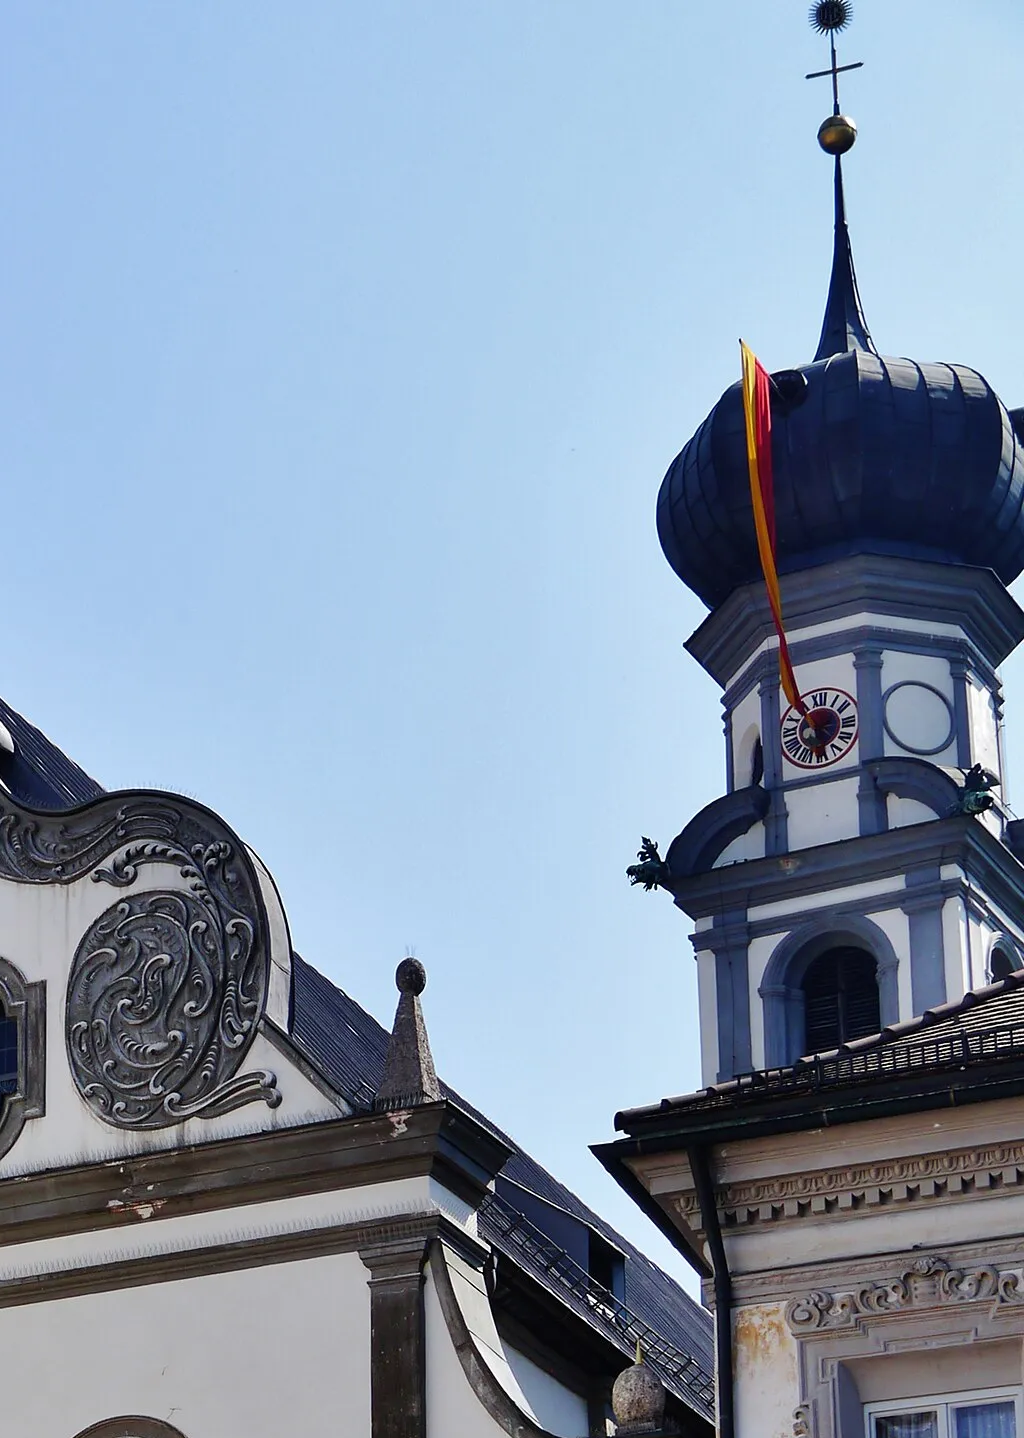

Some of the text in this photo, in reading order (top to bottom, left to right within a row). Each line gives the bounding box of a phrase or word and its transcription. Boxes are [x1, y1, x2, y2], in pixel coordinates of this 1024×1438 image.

[811, 692, 827, 708] XII
[830, 694, 840, 708] I
[837, 699, 851, 714] II
[842, 715, 856, 728] III
